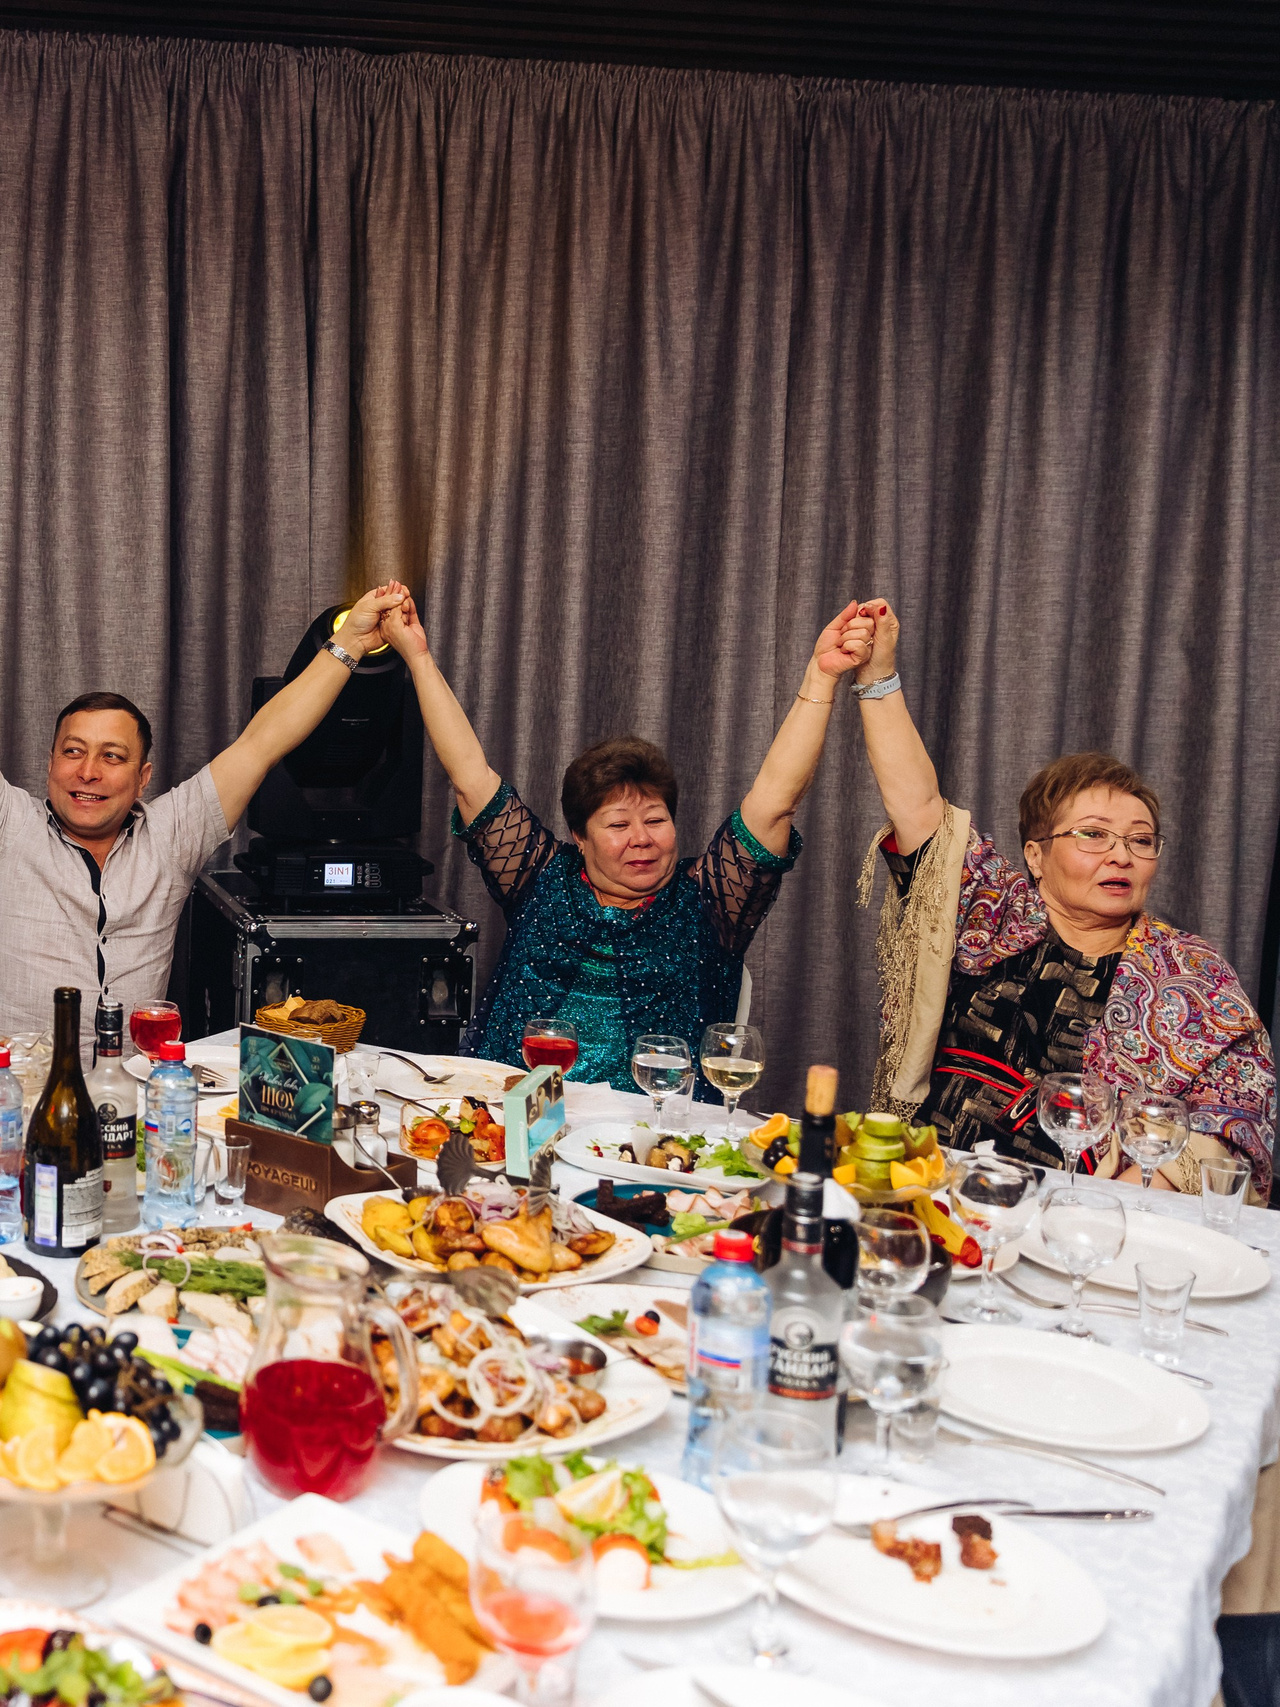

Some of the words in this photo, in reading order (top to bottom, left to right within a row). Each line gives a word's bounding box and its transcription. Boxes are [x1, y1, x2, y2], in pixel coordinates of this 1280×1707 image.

[328, 866, 350, 876] 3IN1
[261, 1084, 295, 1112] ШОУ
[101, 1121, 129, 1133] ССКИЙ
[101, 1130, 134, 1142] НДАРТ
[769, 1357, 836, 1378] ТАНДАРТ
